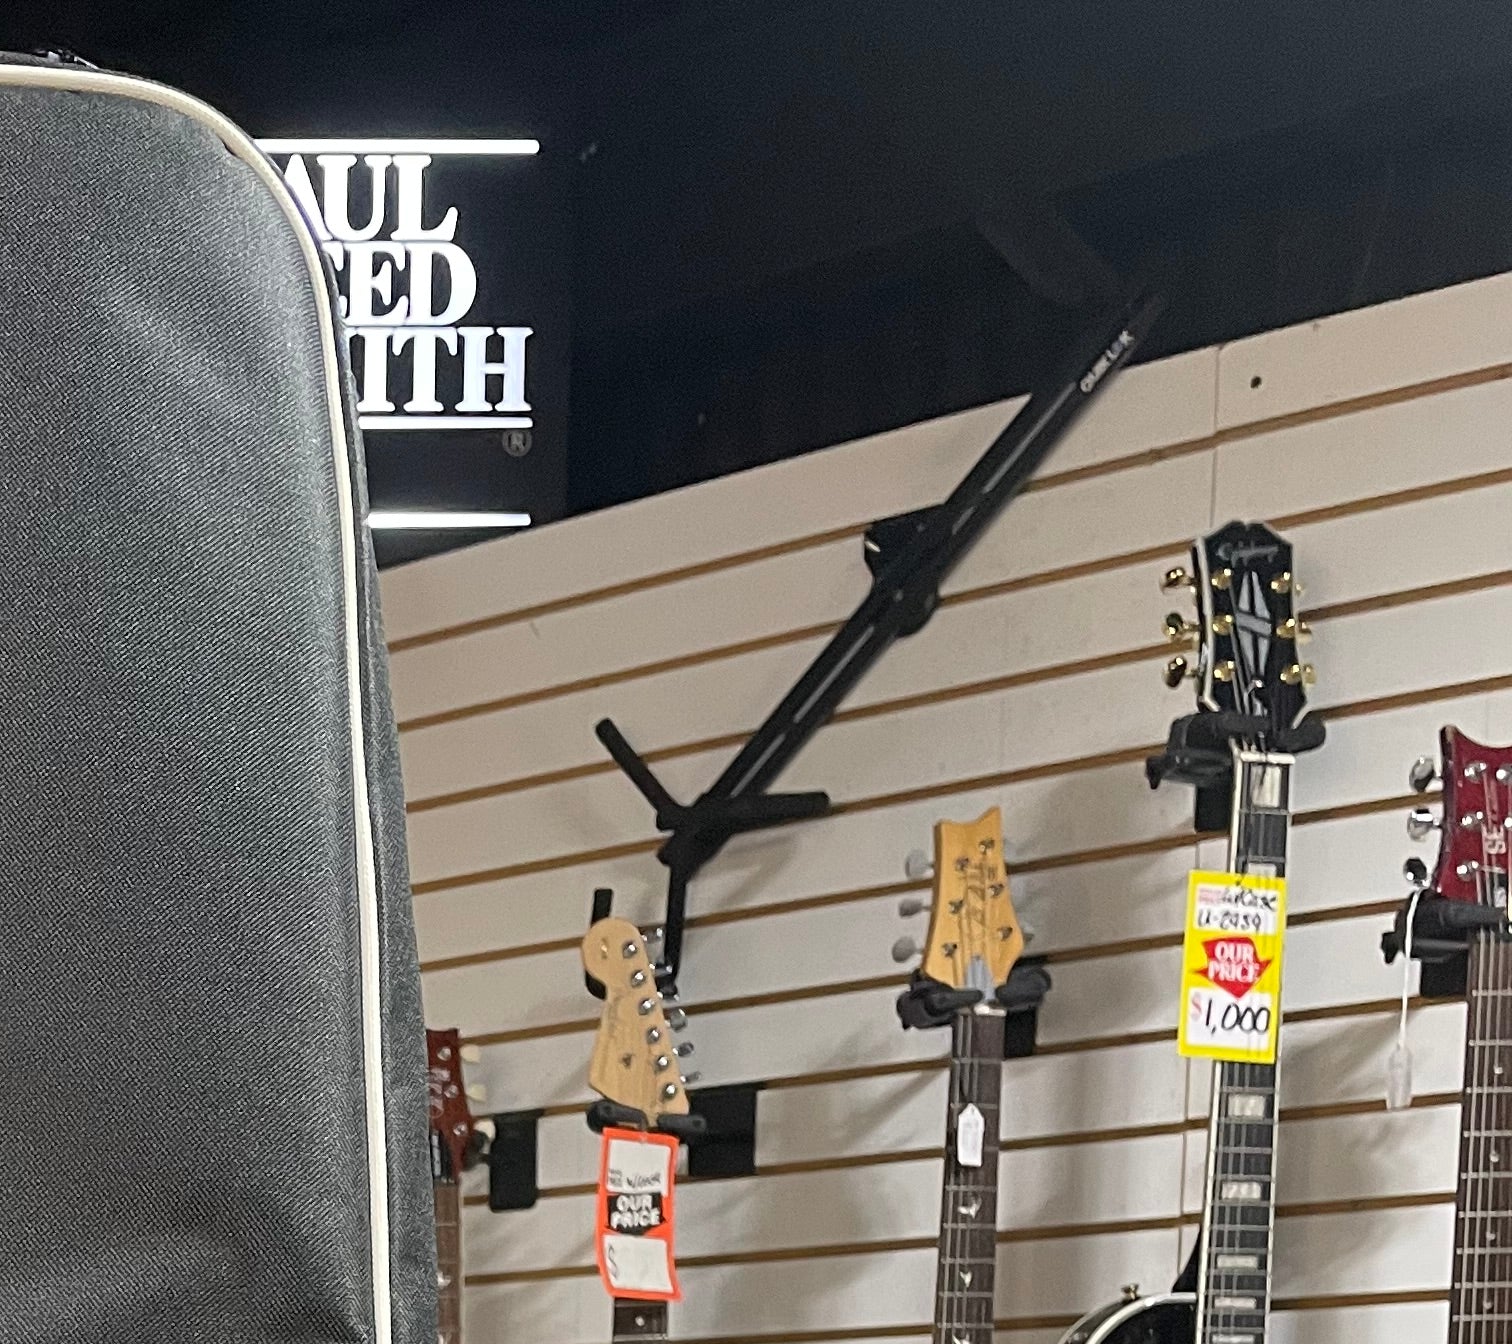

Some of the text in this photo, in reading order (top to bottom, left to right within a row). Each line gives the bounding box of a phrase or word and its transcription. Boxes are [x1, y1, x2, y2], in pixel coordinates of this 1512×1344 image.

[345, 326, 534, 413] ITH
[1214, 941, 1255, 963] OUR
[1207, 961, 1259, 984] PRICE
[616, 1194, 653, 1211] OUR
[609, 1208, 661, 1230] PRICE
